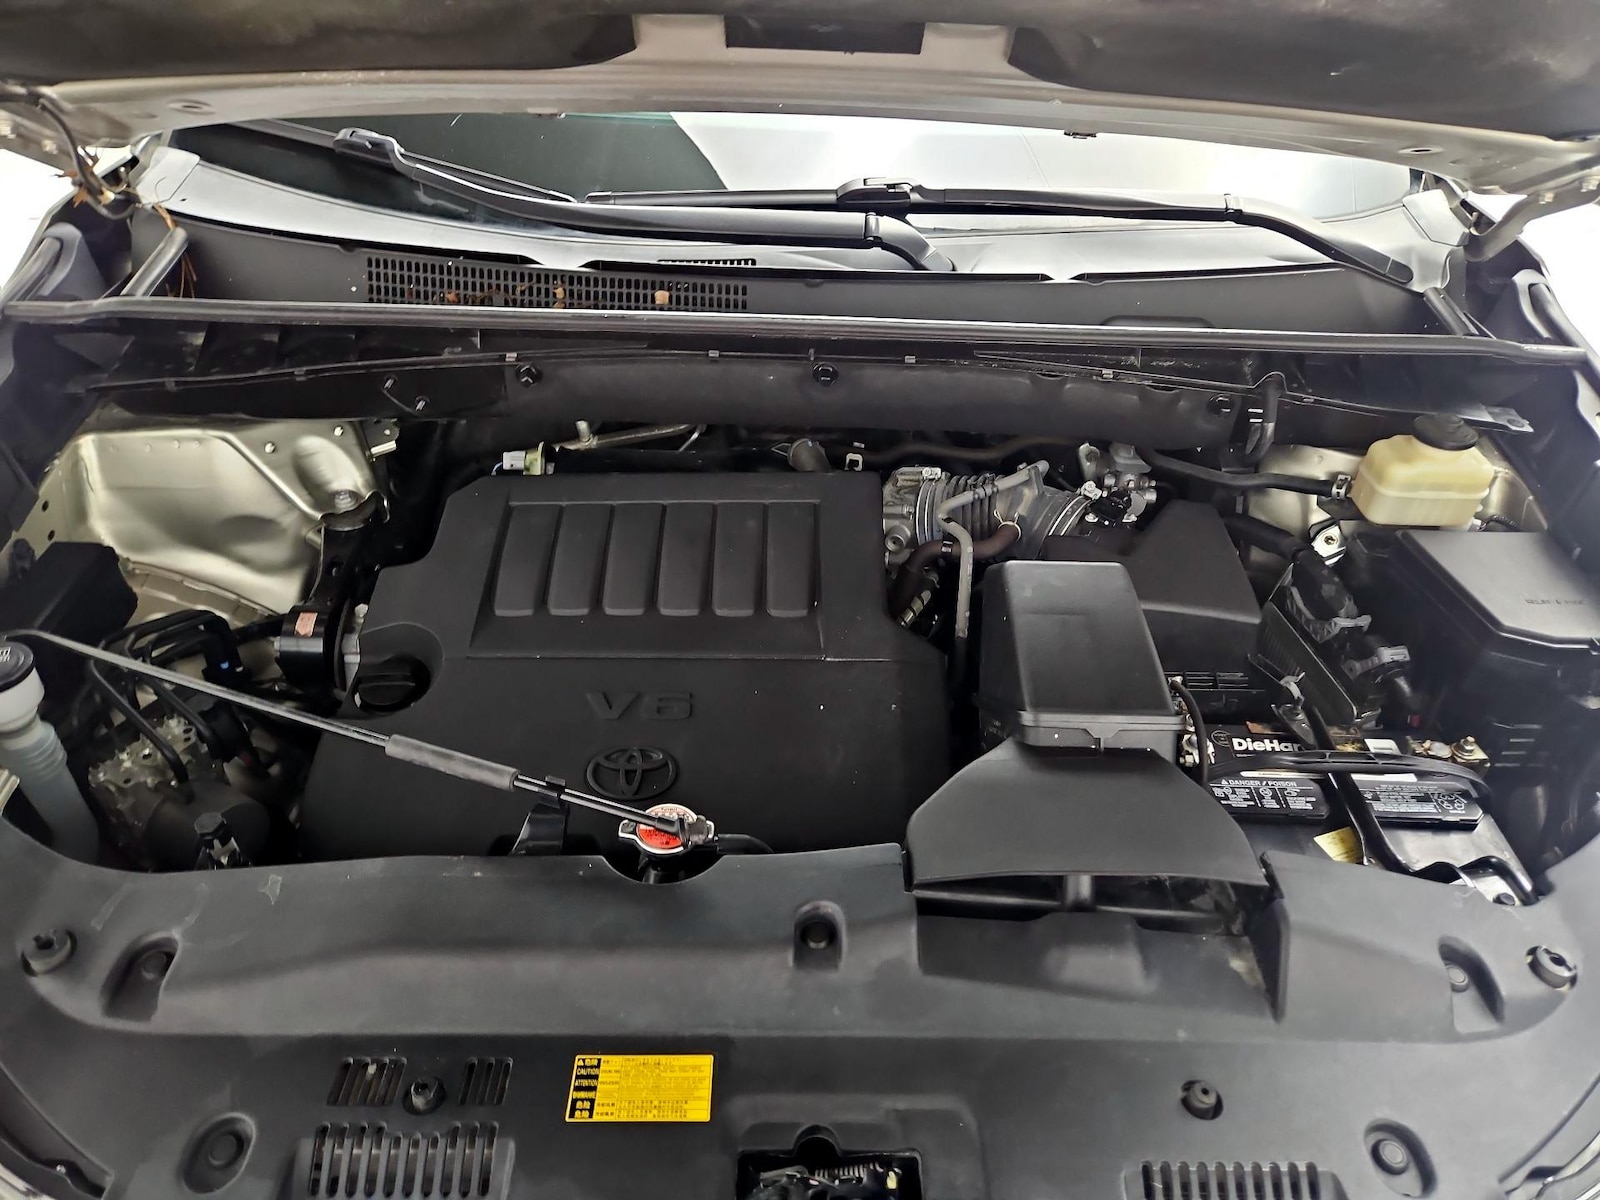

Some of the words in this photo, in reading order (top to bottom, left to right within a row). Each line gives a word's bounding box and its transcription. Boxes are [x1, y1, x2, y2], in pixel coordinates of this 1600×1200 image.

[585, 691, 694, 721] V6
[1232, 738, 1302, 752] DieHar
[574, 1079, 598, 1087] ATTENTION
